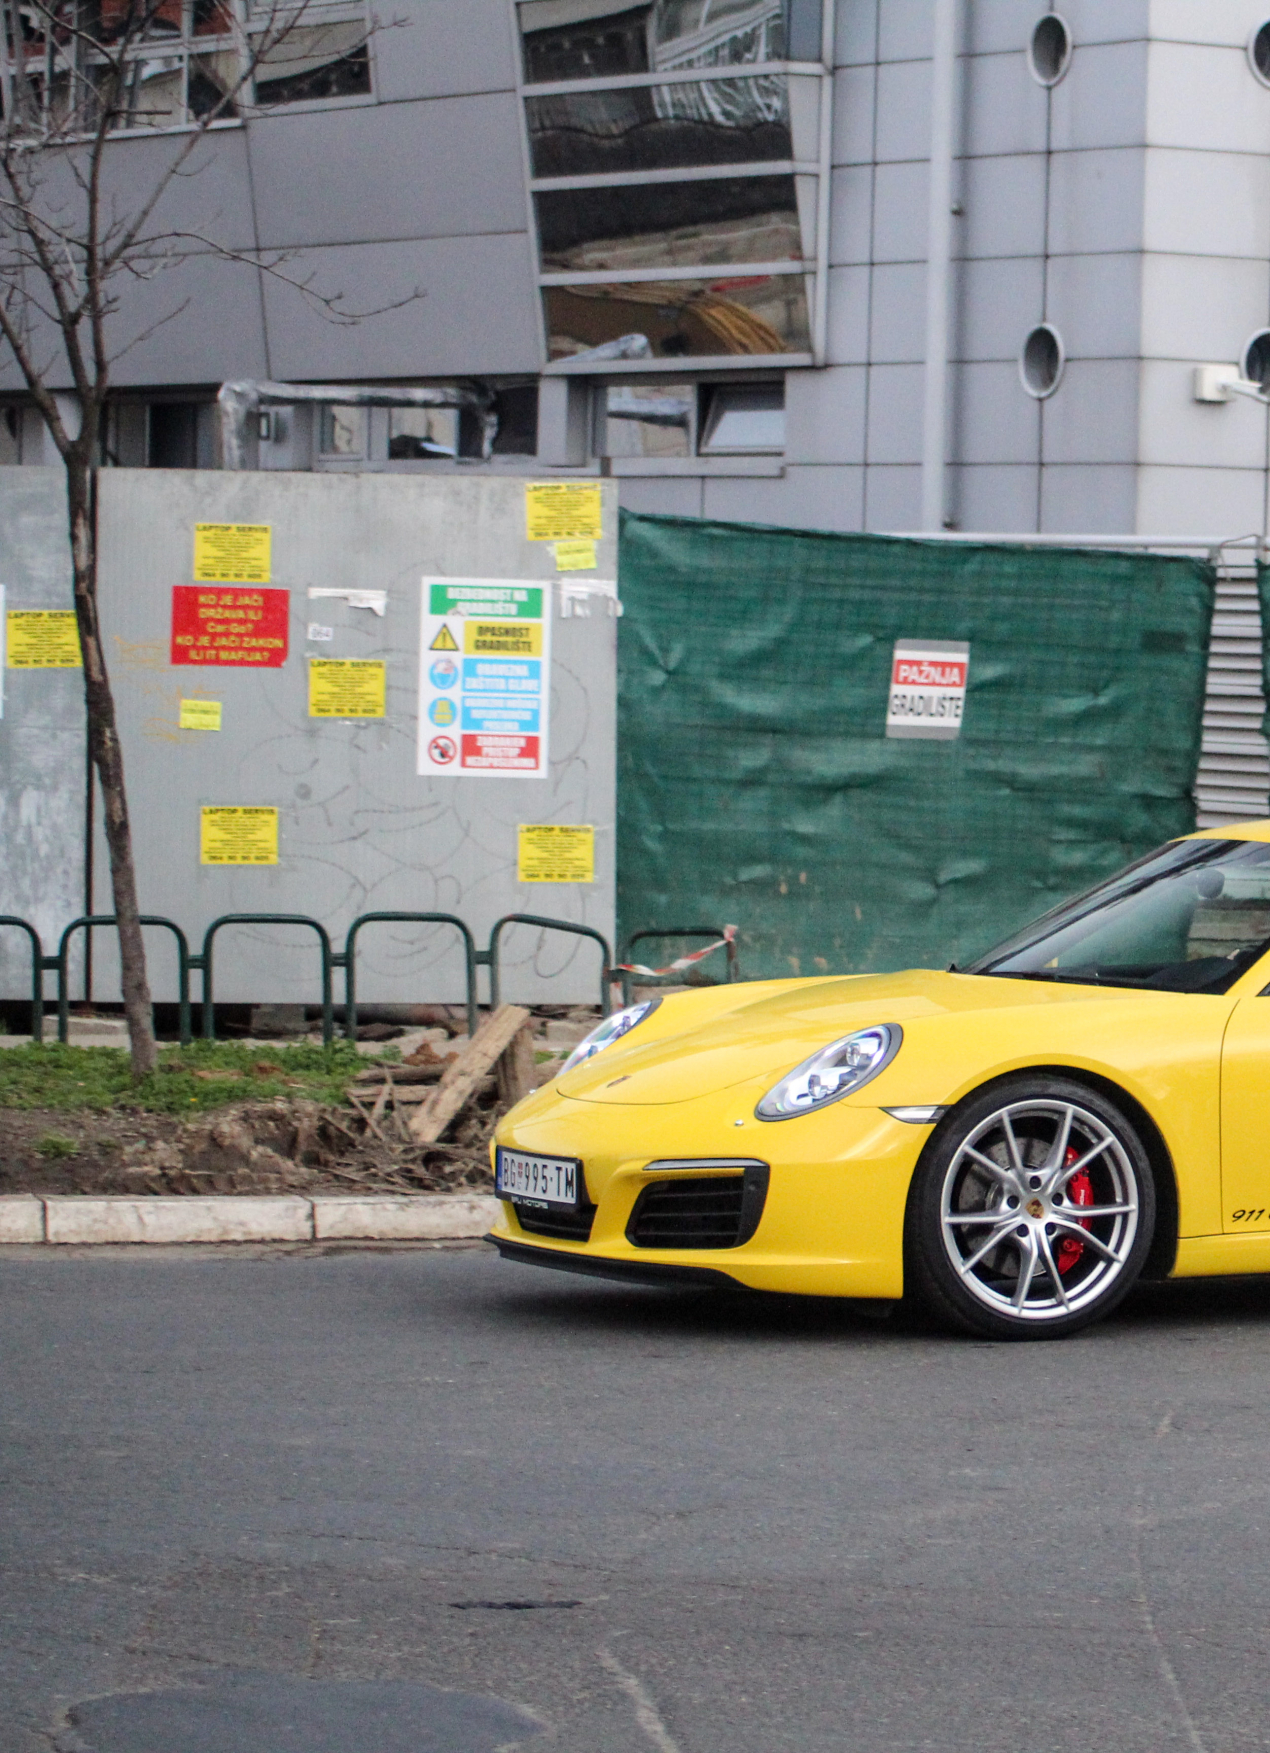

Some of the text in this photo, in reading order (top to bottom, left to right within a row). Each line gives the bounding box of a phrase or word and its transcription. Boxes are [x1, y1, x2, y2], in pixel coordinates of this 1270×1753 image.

[196, 524, 268, 534] LAPTOP SERVIS
[198, 594, 217, 604] KO
[218, 595, 234, 605] JE
[477, 626, 530, 638] OPASNOST
[176, 635, 194, 646] KO
[196, 636, 210, 646] JE
[242, 637, 284, 648] ZAKON
[474, 638, 532, 652] GRADILIŠTE
[219, 651, 270, 662] MAFIJA?
[898, 662, 960, 684] PAŽNJA
[891, 694, 962, 718] GRADILIŠTE
[202, 808, 276, 816] LAPTOP SERVIS
[503, 1157, 516, 1188] BG
[1232, 1209, 1266, 1222] 911
